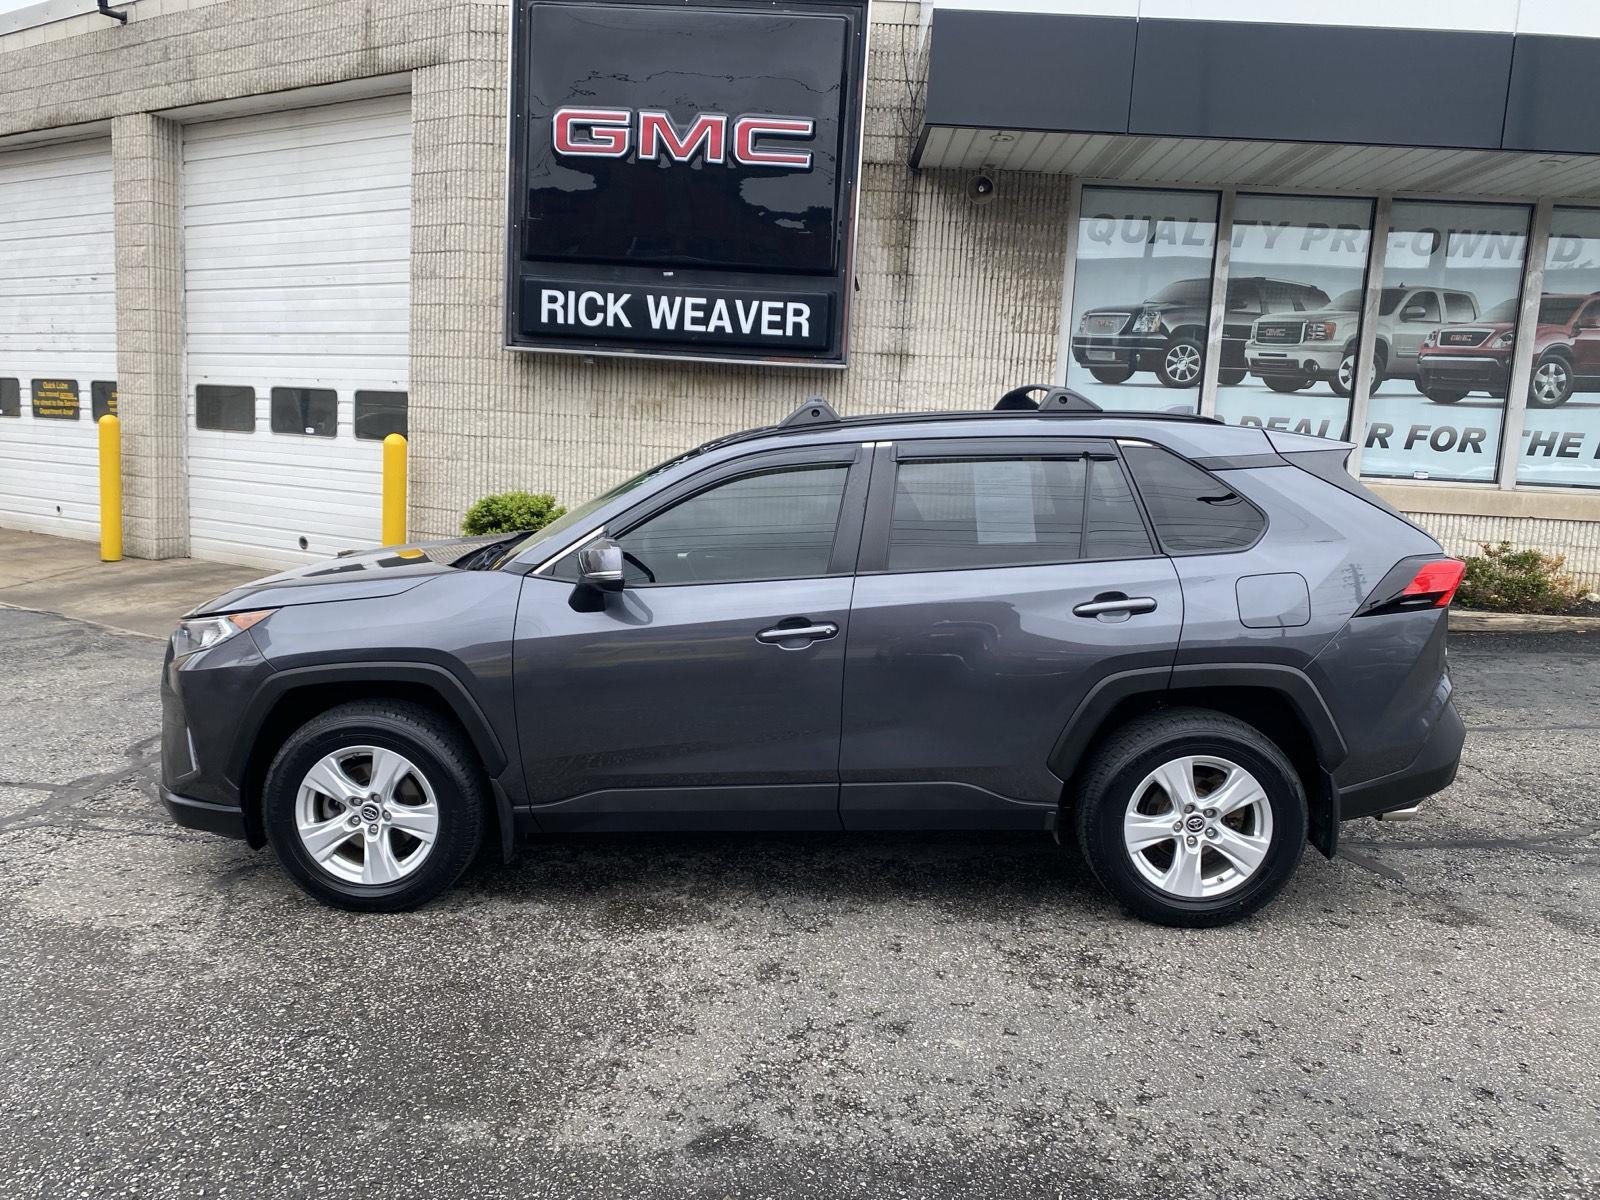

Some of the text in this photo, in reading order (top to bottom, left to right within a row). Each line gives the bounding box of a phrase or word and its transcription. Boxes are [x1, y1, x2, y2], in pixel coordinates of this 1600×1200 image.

[553, 108, 814, 168] GMC
[1087, 213, 1584, 262] QUALTY PR-OWND
[540, 289, 811, 337] RICK WEAVER
[1403, 424, 1487, 454] FOR
